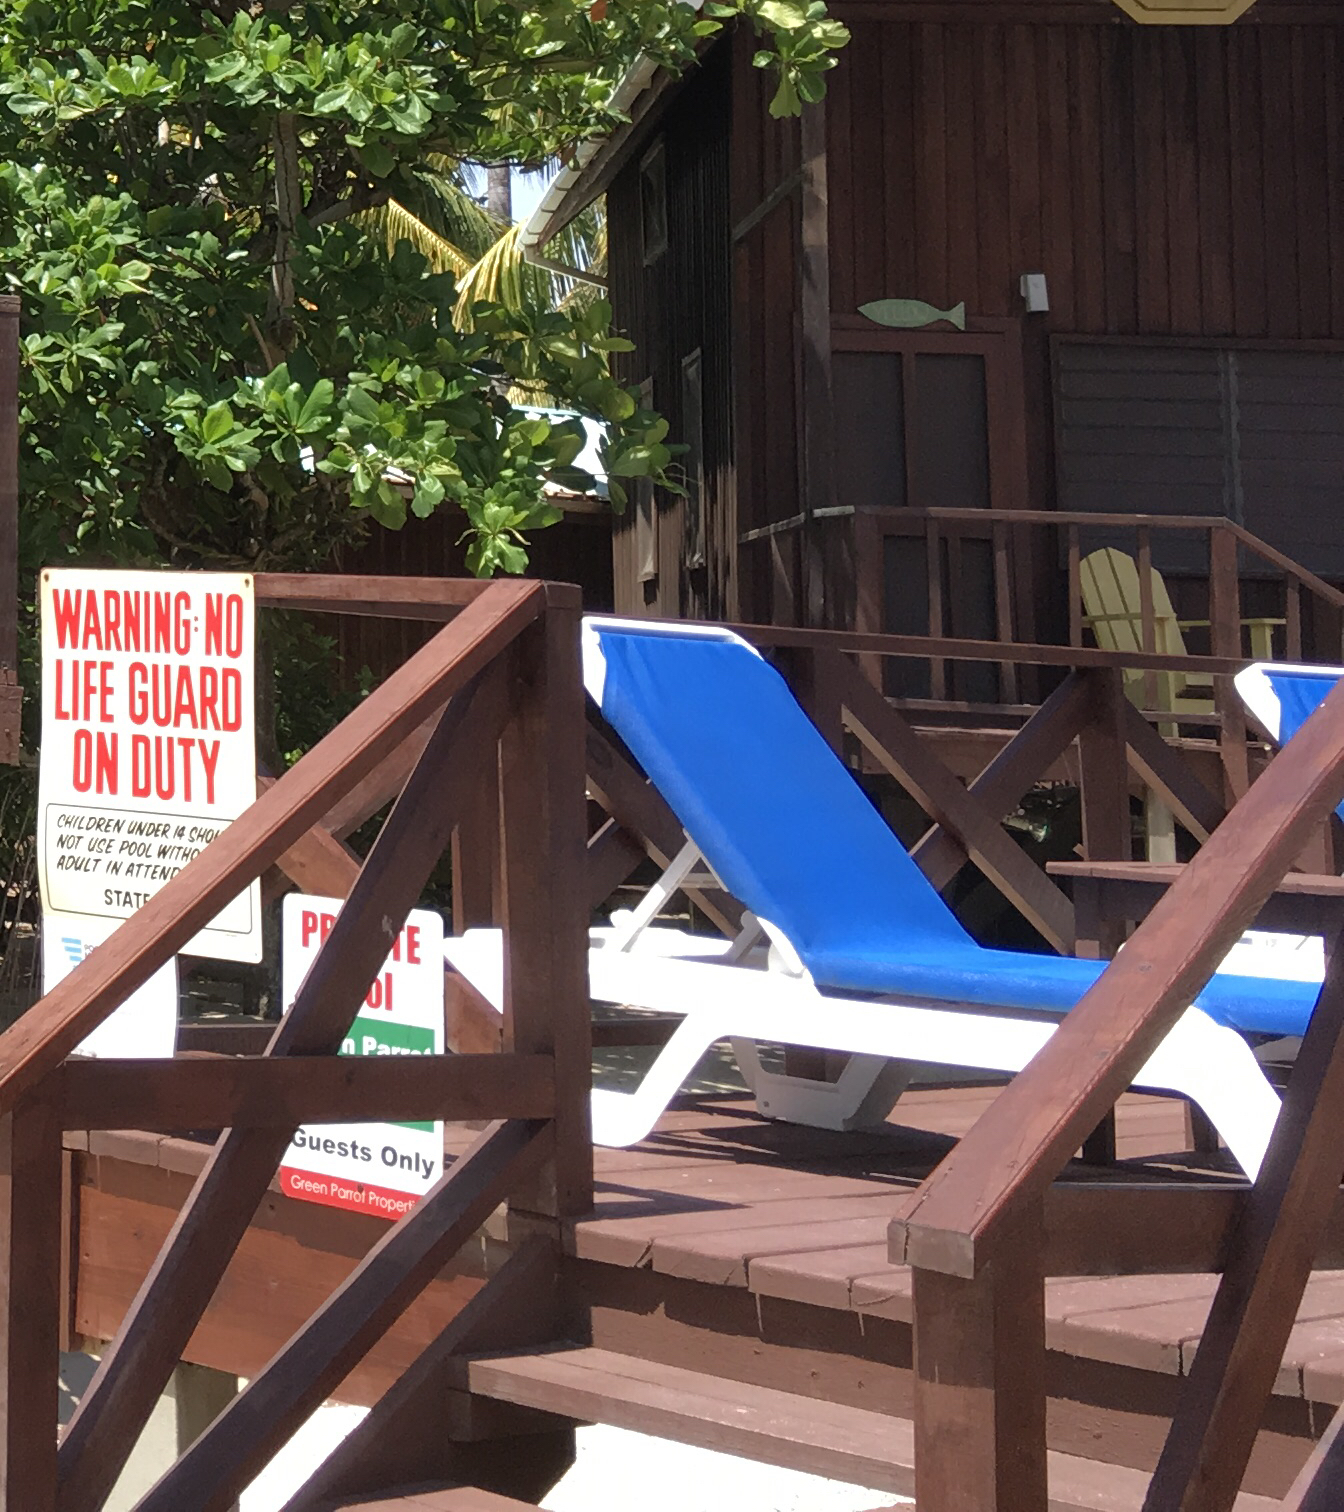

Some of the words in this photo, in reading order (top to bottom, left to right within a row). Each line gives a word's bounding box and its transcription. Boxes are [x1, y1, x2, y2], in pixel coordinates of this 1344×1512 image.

[52, 588, 200, 657] WARNING:
[205, 593, 244, 659] NO
[54, 659, 115, 724] LIFE
[129, 662, 243, 733] GUARD
[72, 728, 119, 796] ON
[132, 734, 221, 805] DUTY
[57, 814, 126, 834] CHILDREN
[127, 820, 171, 839] UNDER
[173, 825, 186, 838] 14
[188, 826, 220, 843] SHO
[57, 834, 84, 850] NOT
[88, 838, 115, 854] USE
[119, 840, 153, 859] POOL
[157, 844, 201, 863] WITHO
[57, 855, 102, 872] ADULT
[106, 860, 123, 876] IN
[125, 862, 181, 881] ATTEND
[292, 1128, 372, 1162] Guests
[381, 1145, 435, 1180] Only
[290, 1174, 328, 1195] Green
[330, 1183, 366, 1203] Parrot
